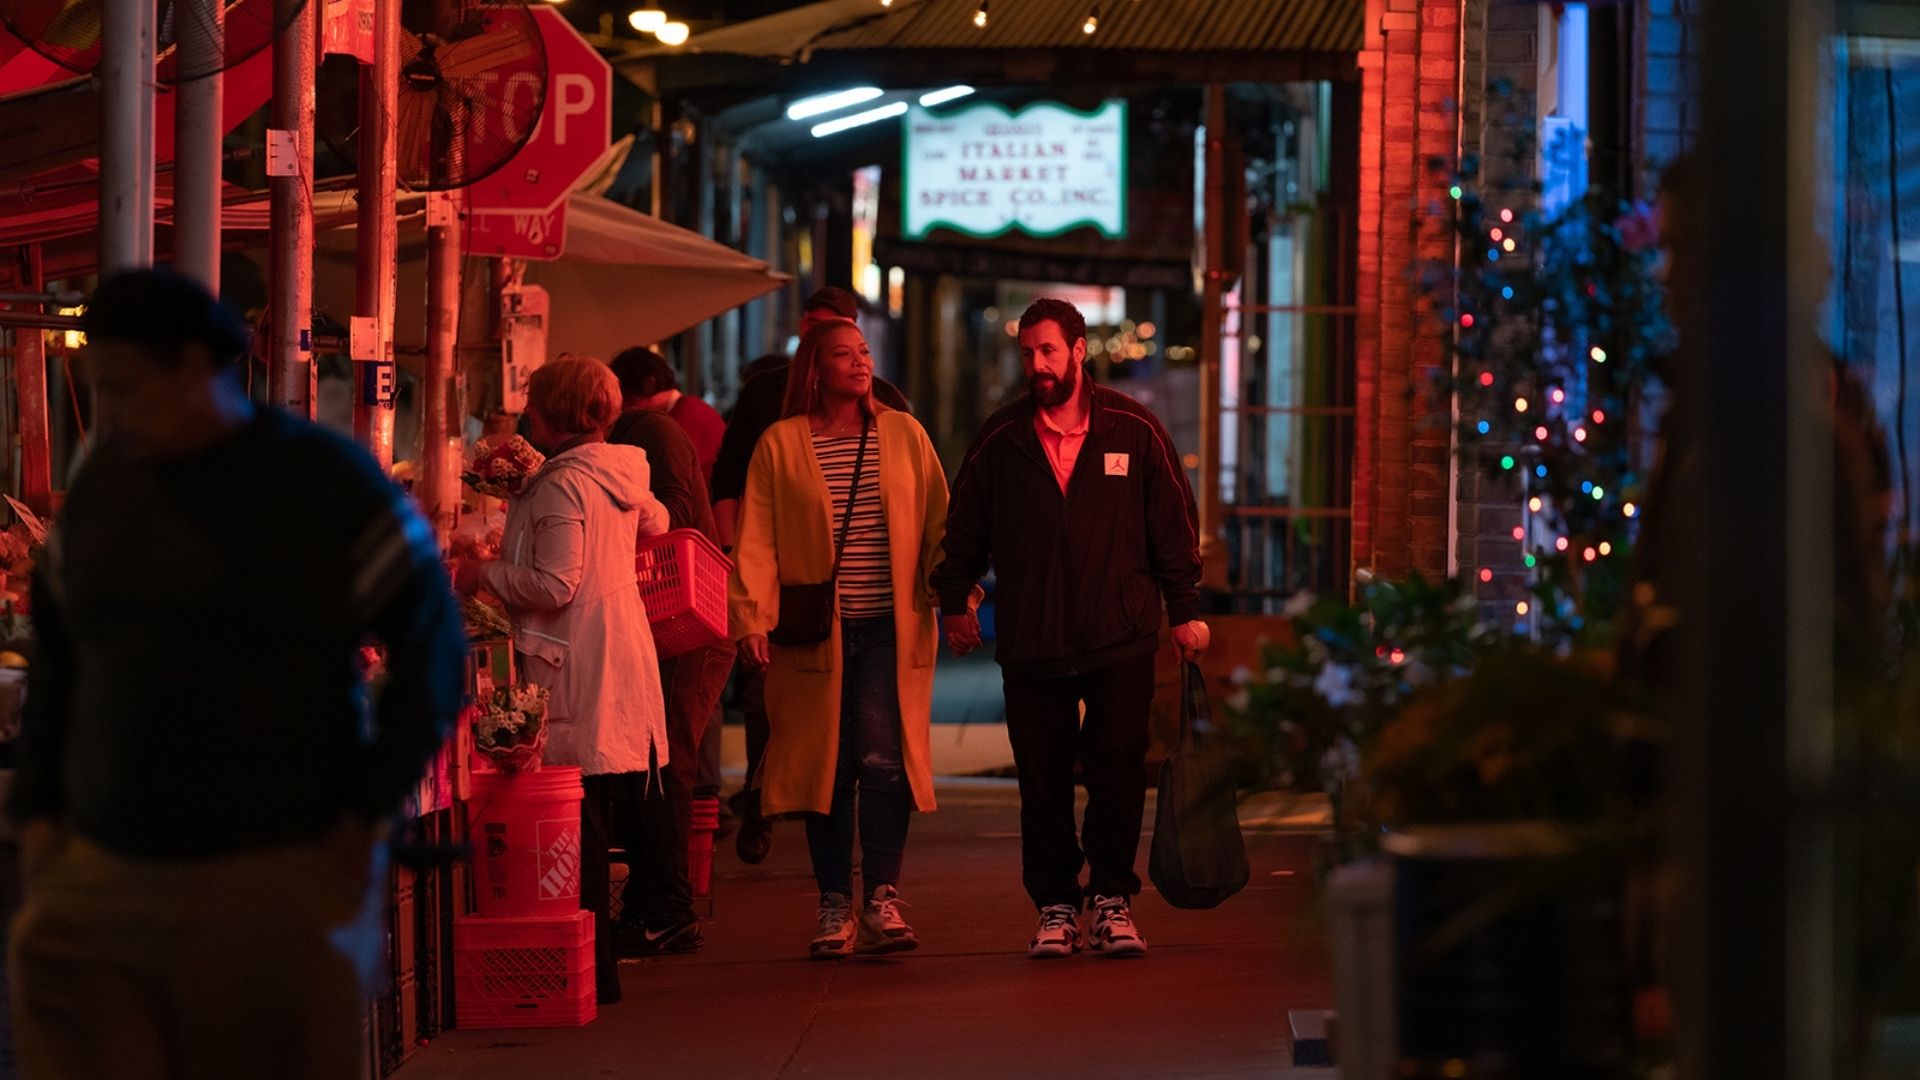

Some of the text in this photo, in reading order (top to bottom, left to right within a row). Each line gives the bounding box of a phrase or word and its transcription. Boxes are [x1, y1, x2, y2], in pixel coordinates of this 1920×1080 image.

[468, 72, 595, 145] TOP
[961, 142, 1067, 159] ITALIAN
[960, 167, 1068, 182] MARKET
[921, 190, 989, 206] SPICE
[545, 827, 572, 859] THE
